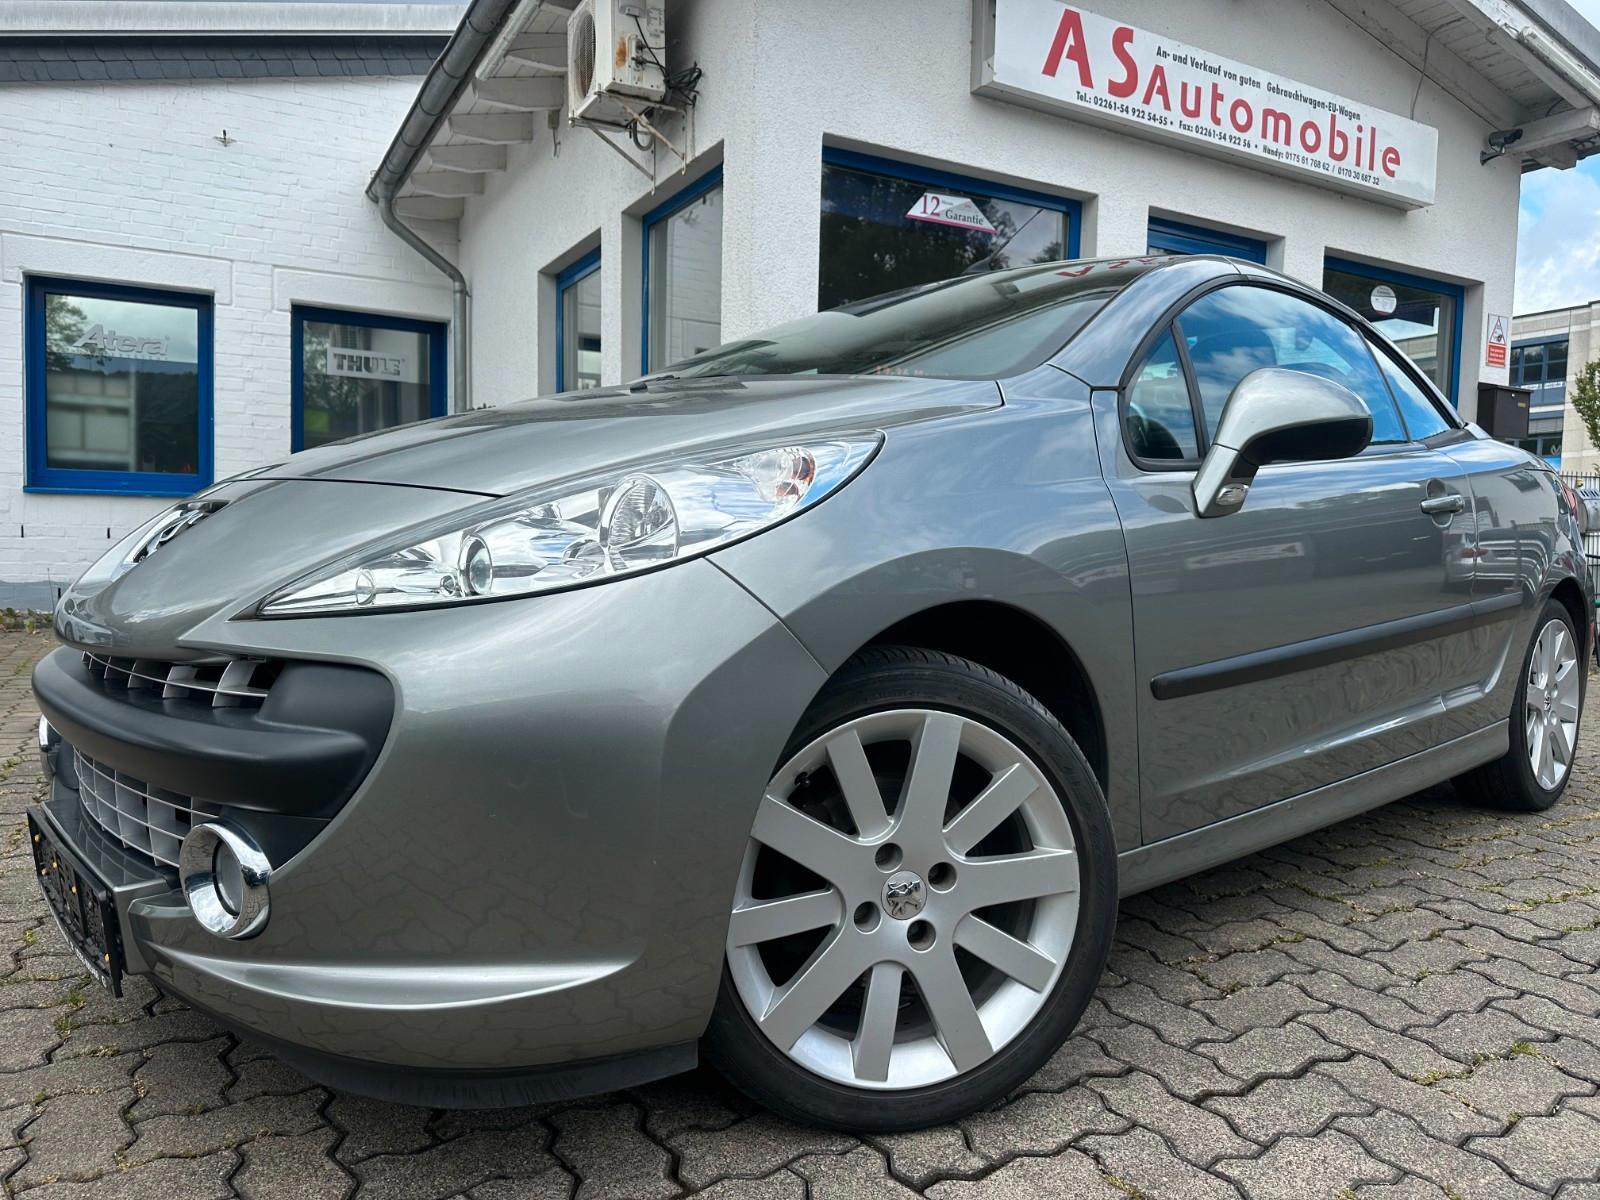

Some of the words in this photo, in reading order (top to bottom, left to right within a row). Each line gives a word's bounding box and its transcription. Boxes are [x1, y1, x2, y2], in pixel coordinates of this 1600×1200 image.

[1156, 46, 1171, 59] An-
[1172, 53, 1188, 65] und
[1190, 56, 1221, 76] Verkauf
[1223, 70, 1238, 81] von
[1239, 75, 1261, 89] guten
[1076, 90, 1092, 103] Tel.:
[1093, 96, 1130, 115] 02261-54
[1131, 108, 1146, 120] 922
[1147, 112, 1168, 126] 54-55
[1178, 120, 1194, 132] Fax:
[1195, 124, 1227, 142] 02261-54
[1228, 134, 1241, 146] 922
[1242, 138, 1252, 149] 56
[1285, 151, 1300, 163] 0175
[1301, 155, 1309, 165] 61
[1337, 166, 1352, 178] 0170
[920, 194, 941, 217] 12
[945, 208, 984, 226] Garantie
[72, 323, 168, 357] Atera
